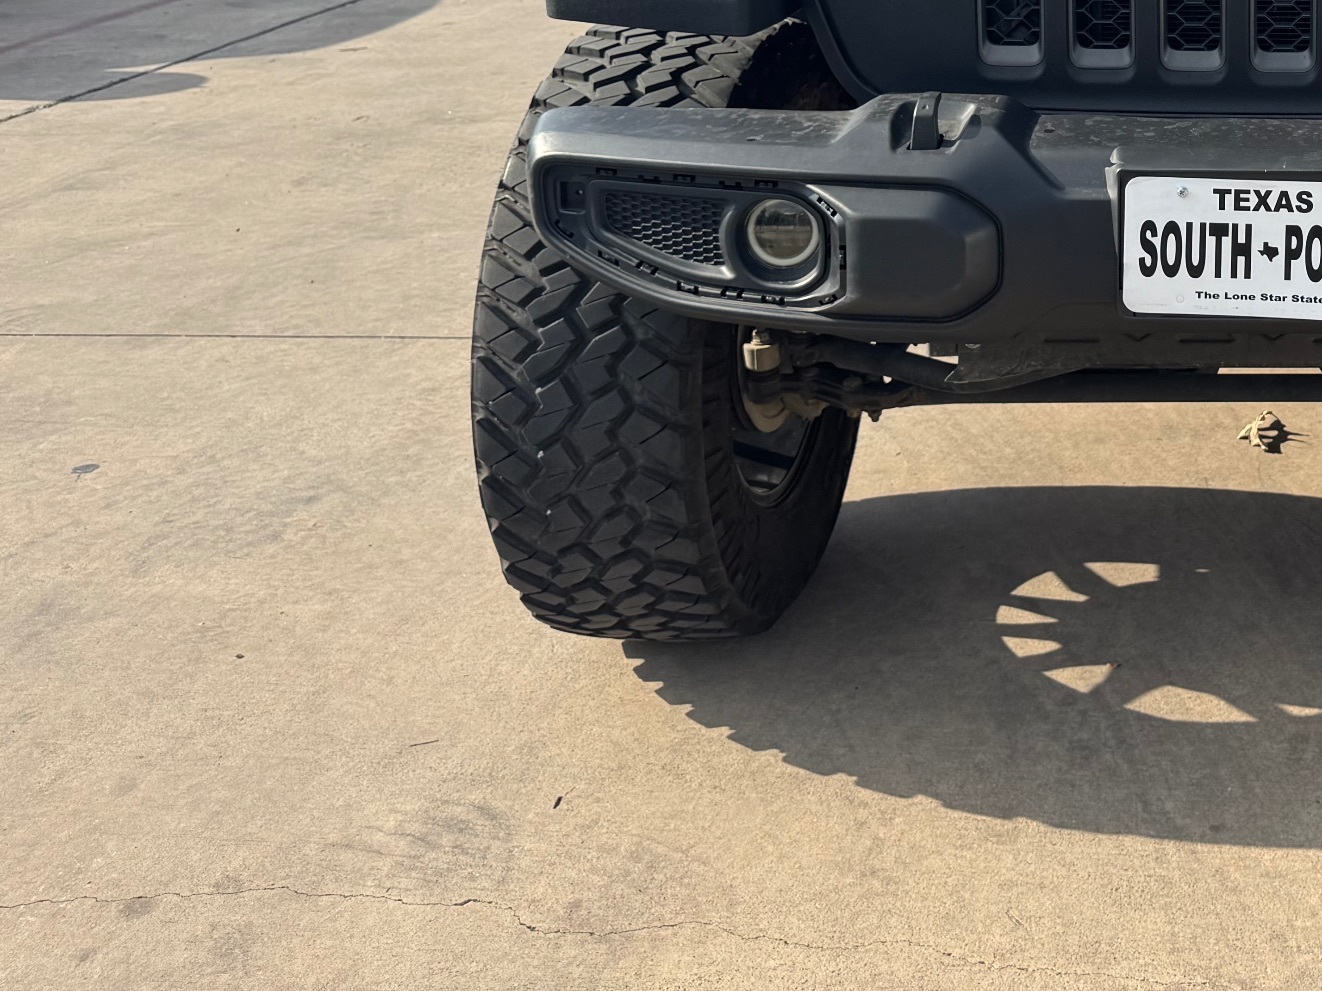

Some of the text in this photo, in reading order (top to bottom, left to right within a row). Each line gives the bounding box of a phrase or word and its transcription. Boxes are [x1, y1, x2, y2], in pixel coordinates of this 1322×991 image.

[1213, 188, 1314, 213] TEXAS
[1138, 219, 1252, 280] SOUTH
[1195, 290, 1220, 301] The
[1224, 291, 1255, 301] Lone
[1260, 293, 1288, 303] Star
